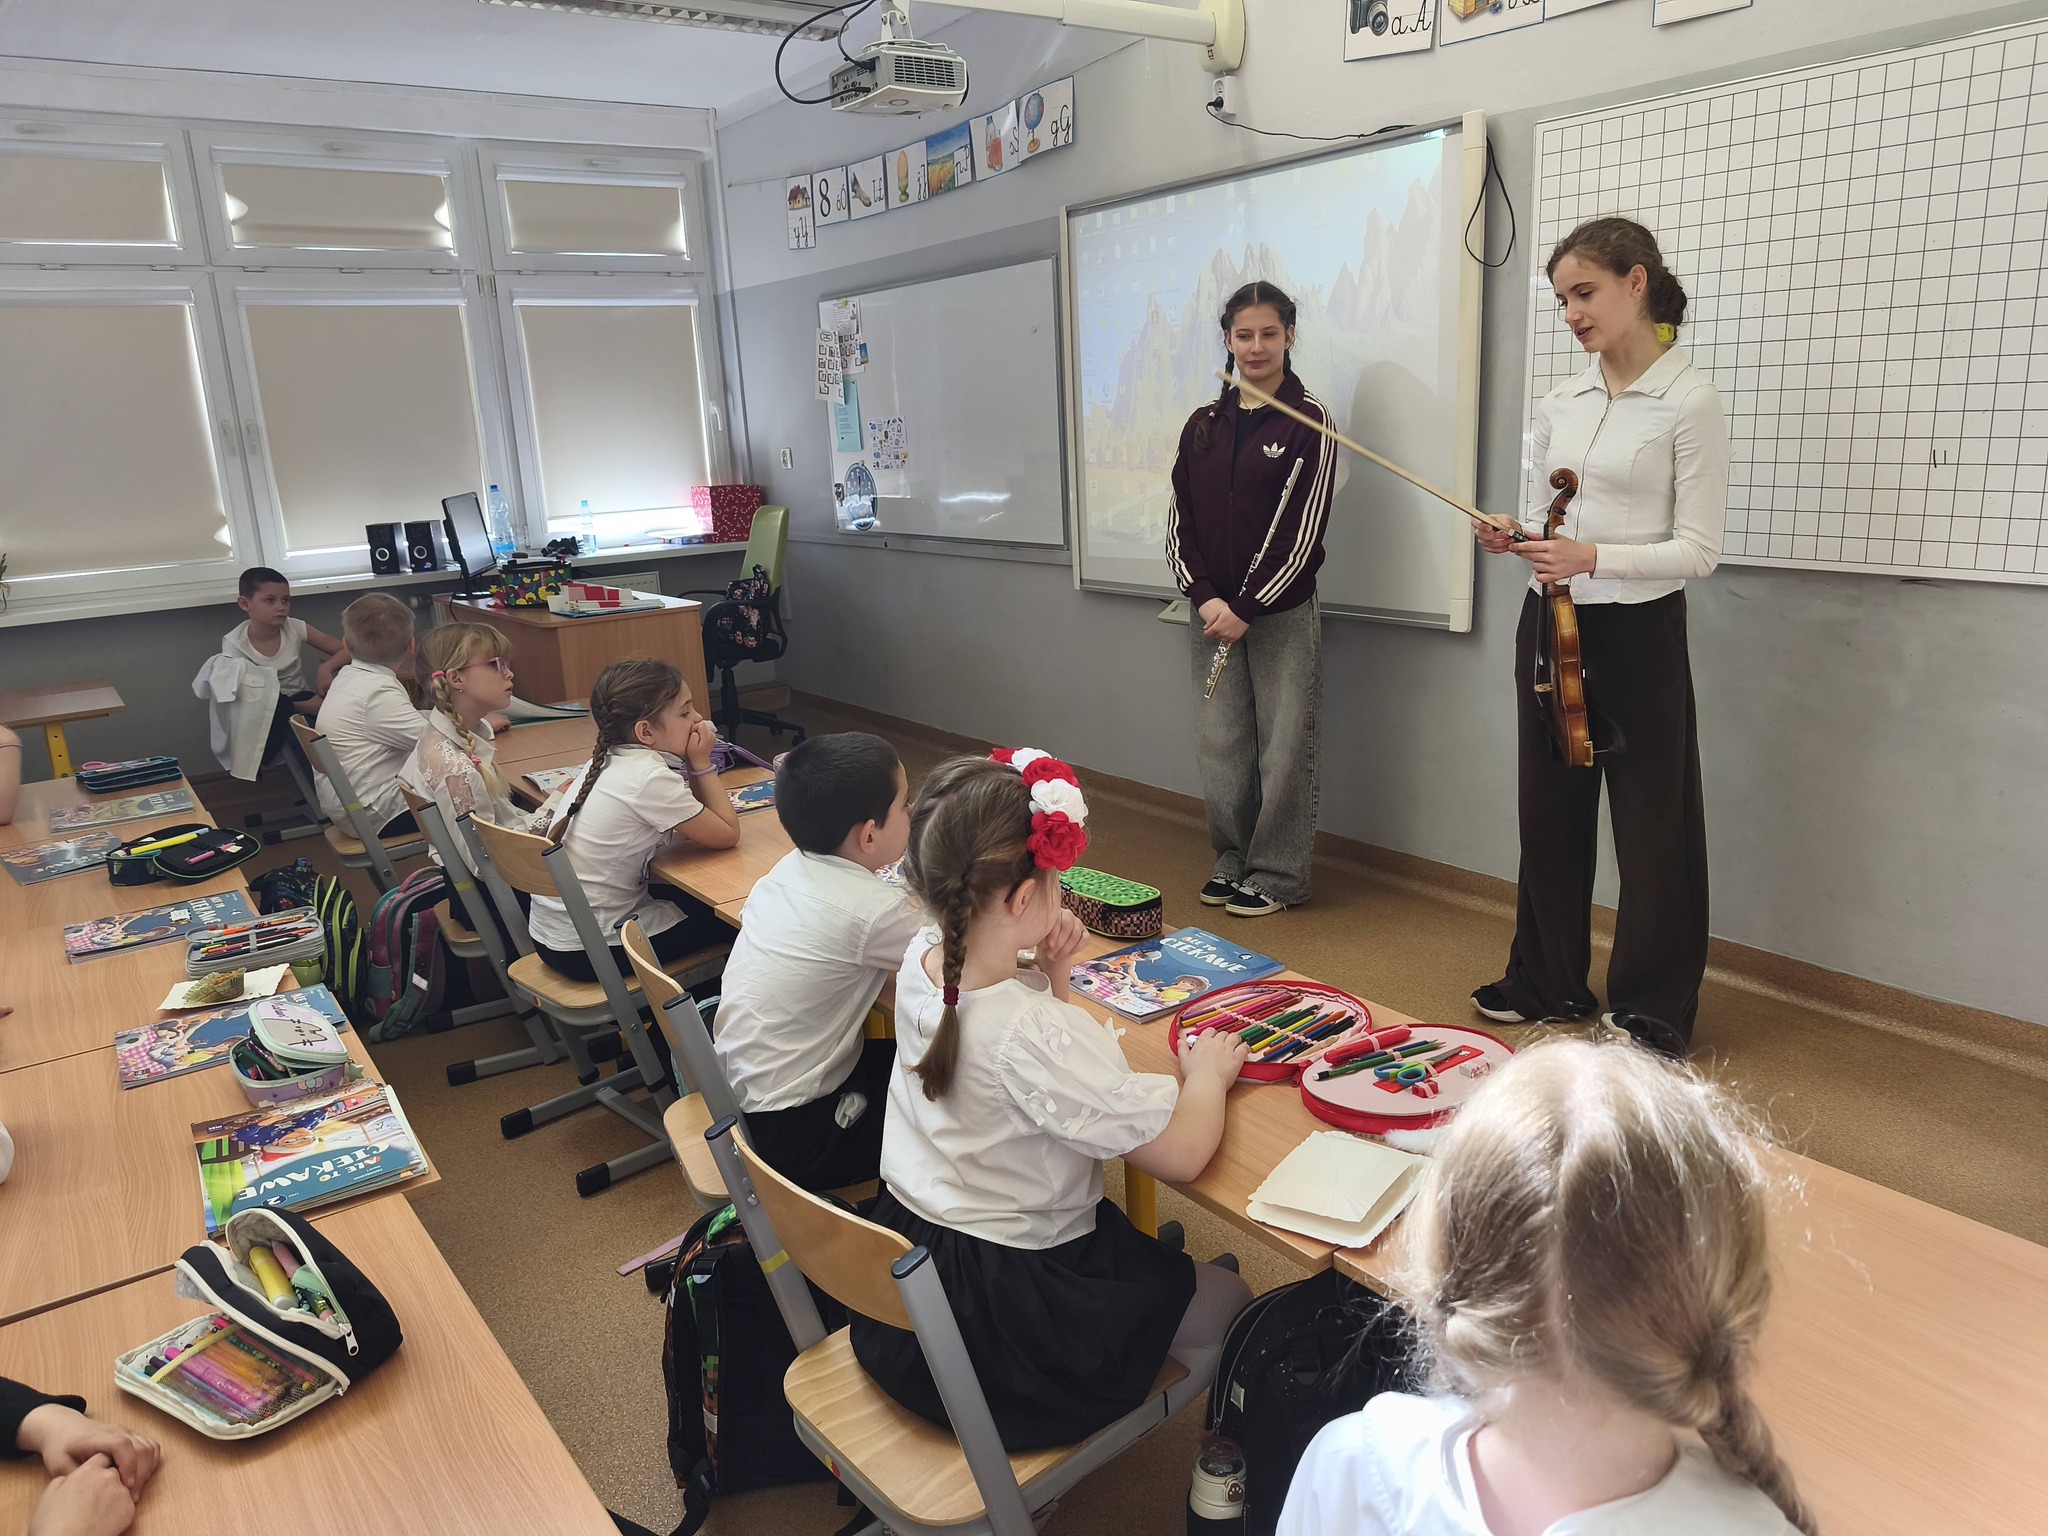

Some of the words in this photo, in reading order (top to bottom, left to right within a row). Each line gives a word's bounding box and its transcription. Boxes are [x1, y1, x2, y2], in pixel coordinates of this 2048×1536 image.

[819, 178, 831, 217] 8
[1181, 936, 1205, 947] ALE
[1159, 937, 1247, 974] CIEKAWE
[237, 1142, 390, 1201] CIEKAWE
[344, 1156, 381, 1174] ALE
[319, 1170, 341, 1182] TO
[266, 1195, 282, 1206] 2
